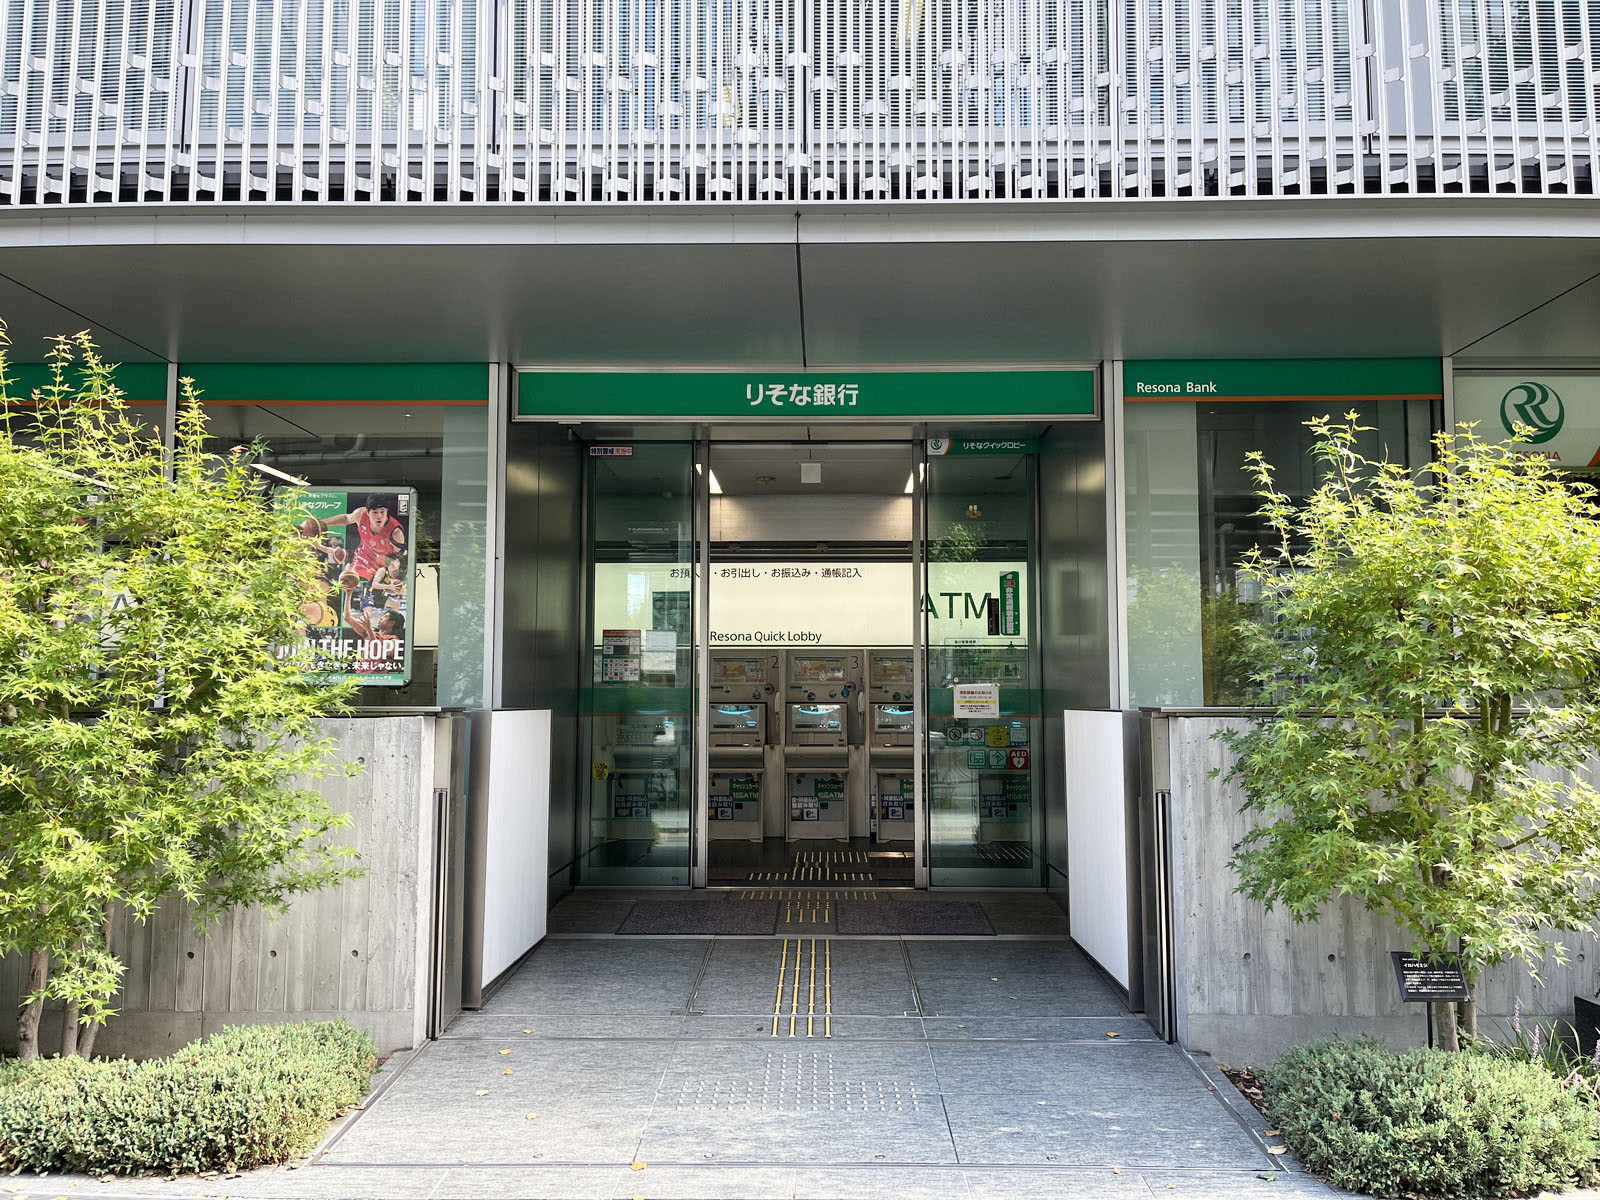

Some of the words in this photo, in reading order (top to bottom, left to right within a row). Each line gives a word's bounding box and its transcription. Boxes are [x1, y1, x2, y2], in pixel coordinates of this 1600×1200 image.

[1136, 382, 1181, 393] Resona
[1186, 381, 1217, 393] Bank
[746, 383, 859, 406] りそな銀行
[591, 447, 632, 455] 特別警戒実施中
[963, 442, 1026, 450] りそなクイックロビー
[1515, 451, 1561, 461] ESONA
[920, 592, 992, 619] ATM
[710, 631, 752, 642] Resona
[754, 631, 785, 642] Quick
[788, 631, 822, 644] Lobby
[319, 639, 353, 660] THE
[357, 639, 405, 660] HOPE
[771, 655, 779, 669] 2
[851, 655, 859, 669] 3
